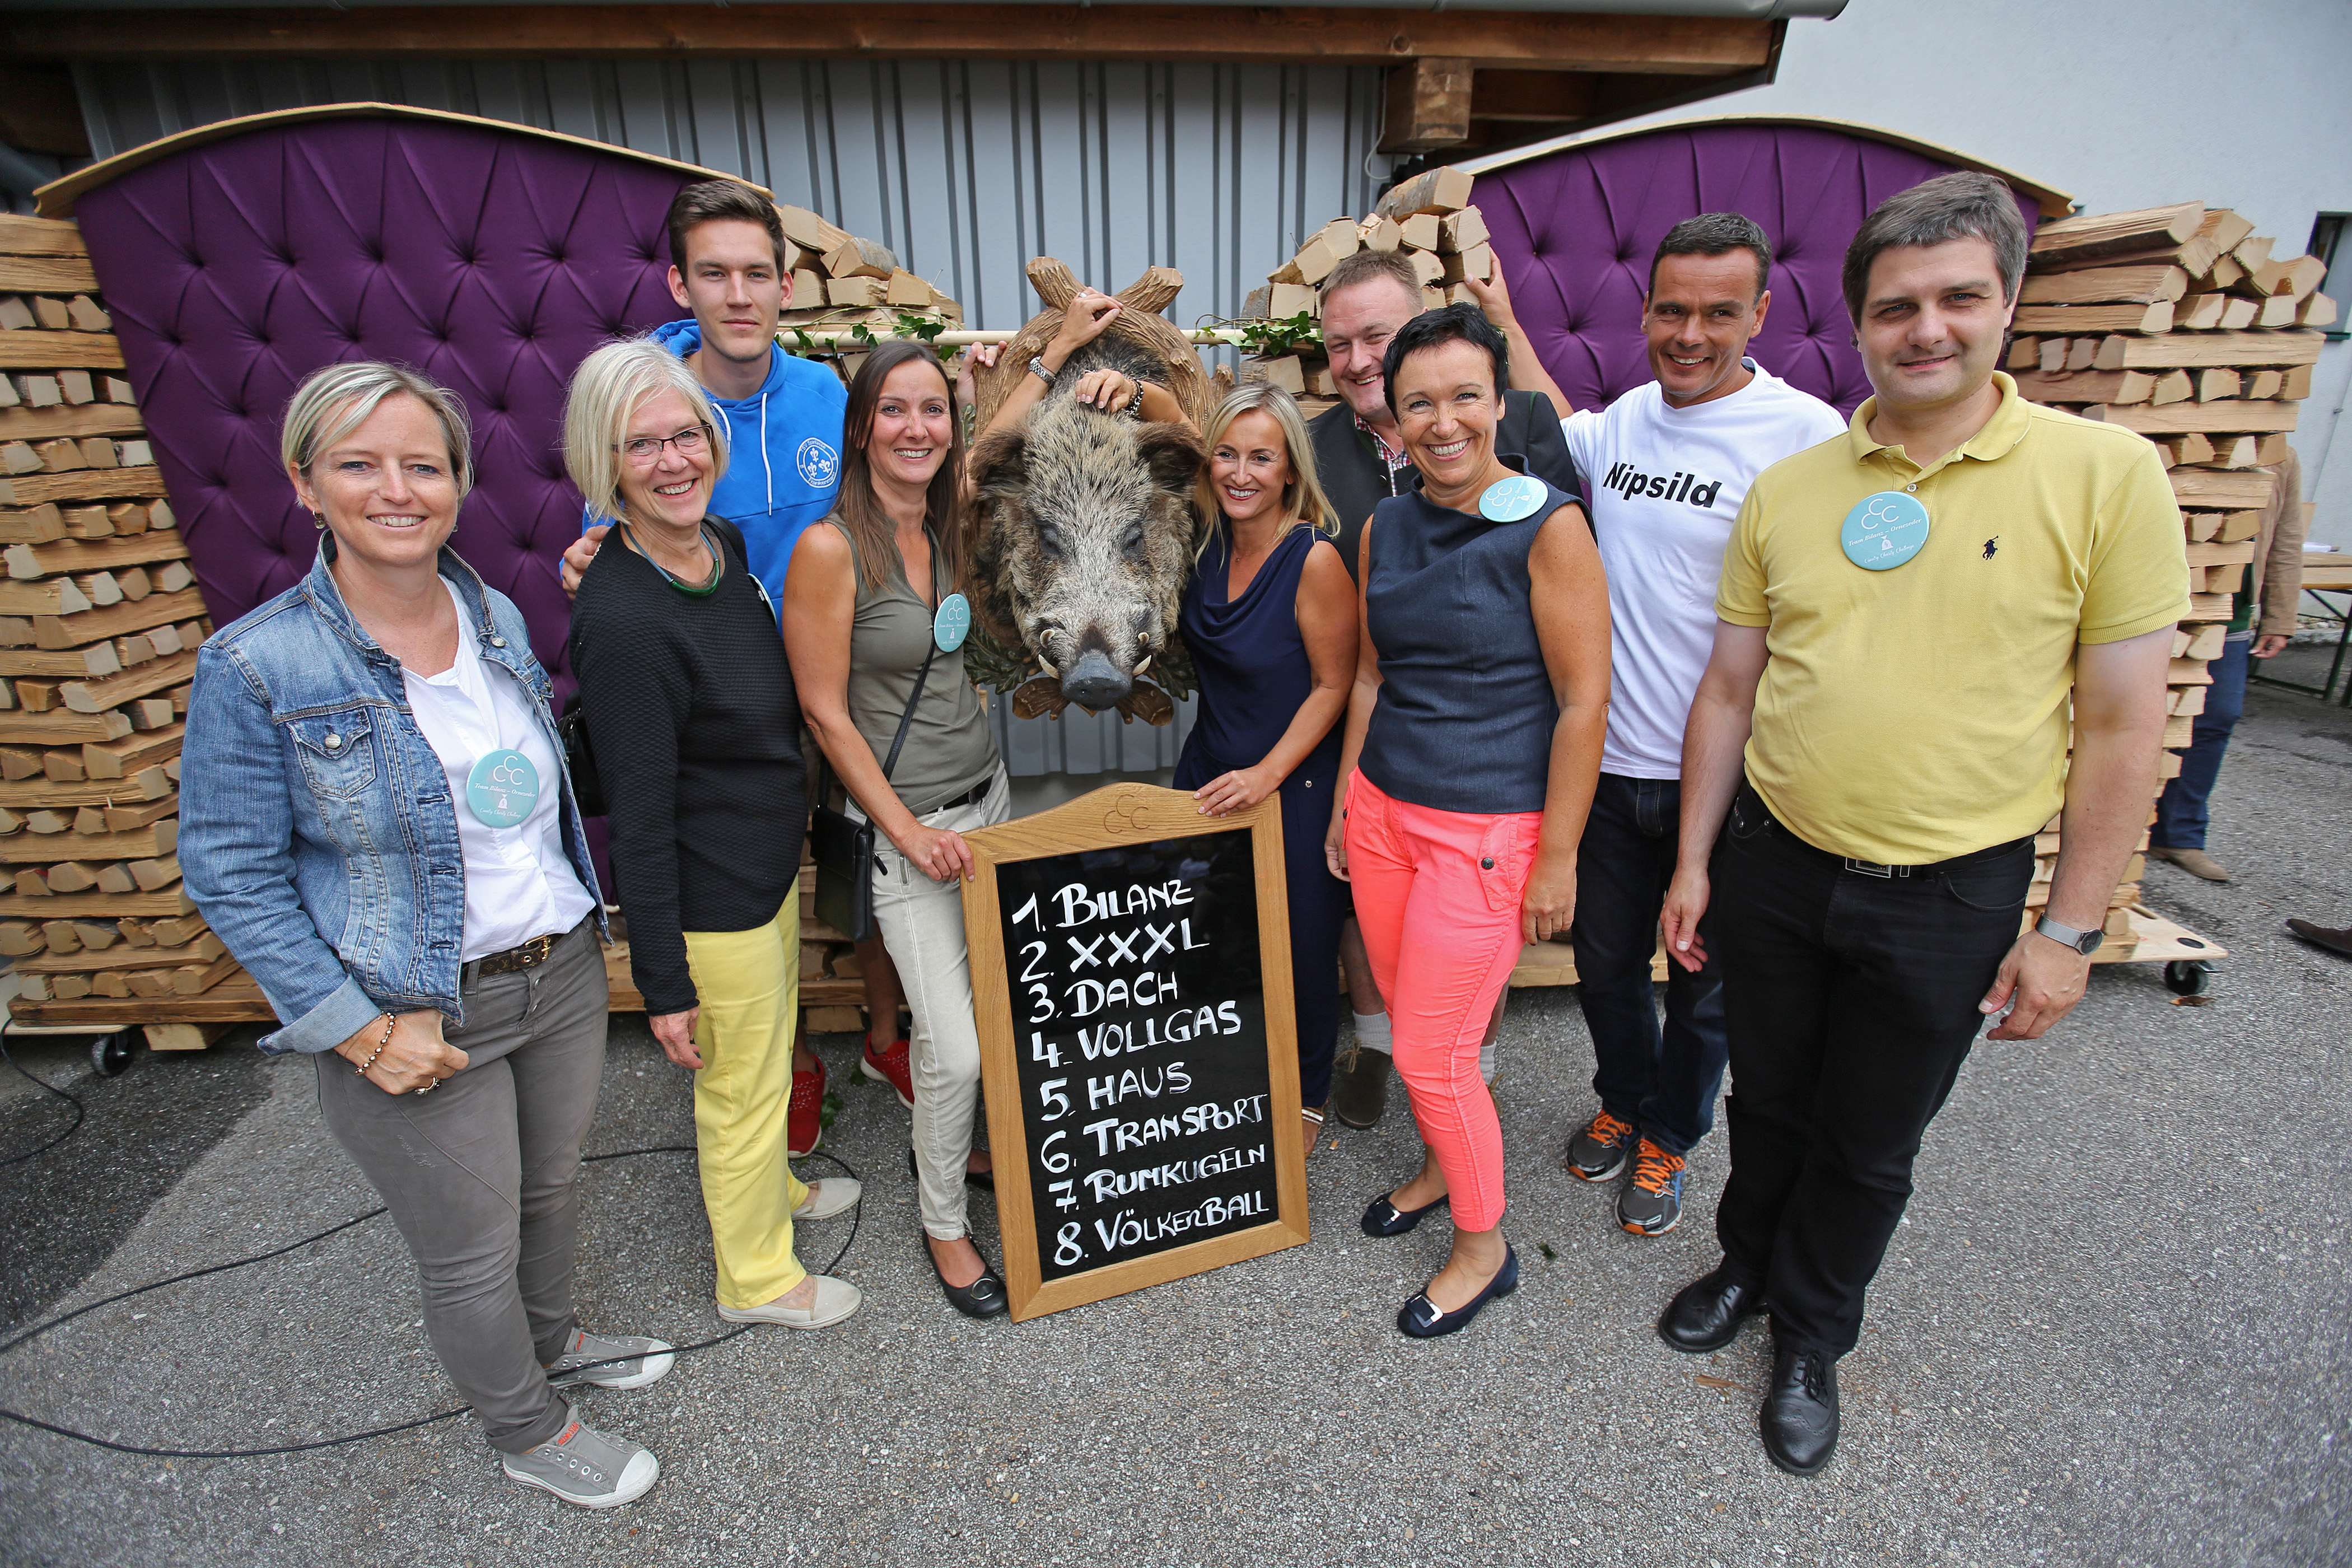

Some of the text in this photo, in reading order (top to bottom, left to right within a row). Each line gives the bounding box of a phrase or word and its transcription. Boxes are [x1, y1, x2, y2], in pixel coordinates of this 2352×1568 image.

[1603, 461, 1723, 508] Nipsild
[1865, 531, 1884, 541] Bilanz
[1011, 879, 1194, 932] 1. BILANZ
[1019, 918, 1210, 983] 2. XXXL
[1028, 972, 1178, 1023] 3. DACH
[1077, 1000, 1242, 1061] VOLLGAS
[1039, 1062, 1192, 1121] 5. HAUS
[1040, 1094, 1268, 1174] 6. TRANSPORT
[1048, 1144, 1266, 1214] 7. RUMKUGELN
[1053, 1222, 1089, 1266] 8.
